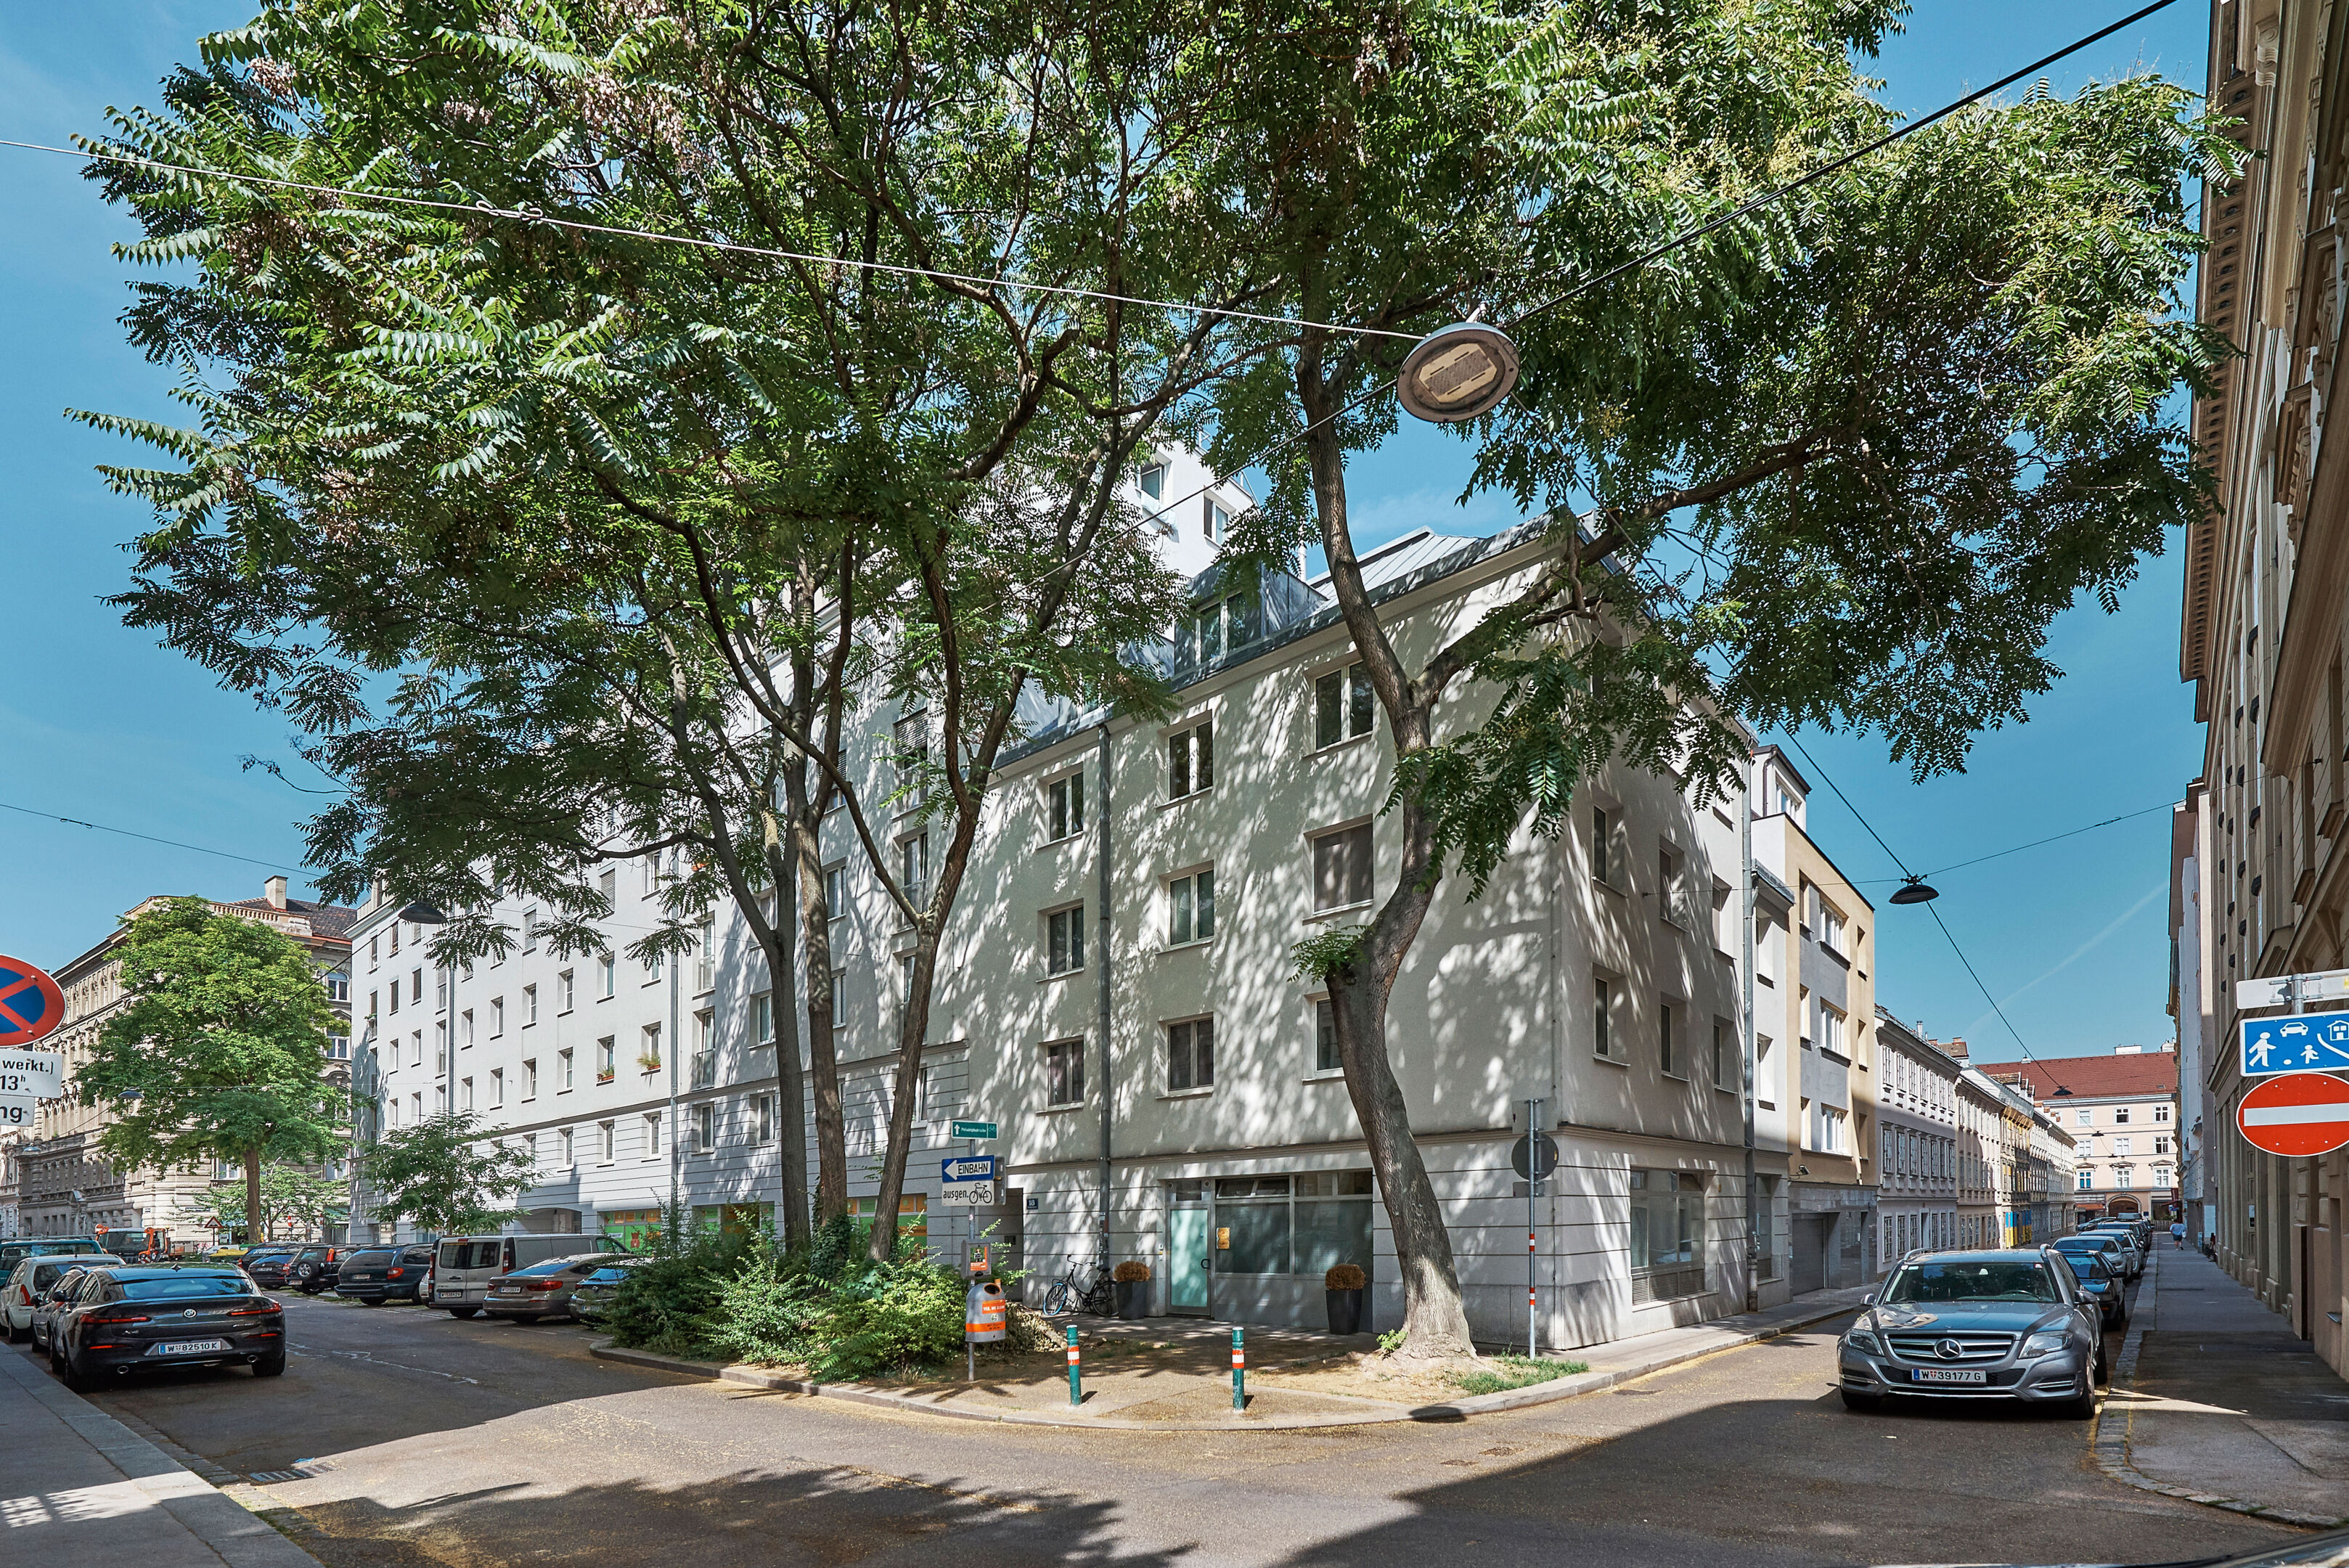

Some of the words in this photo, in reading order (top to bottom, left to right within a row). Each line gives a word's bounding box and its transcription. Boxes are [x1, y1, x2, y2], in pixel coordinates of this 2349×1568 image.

[958, 1162, 988, 1175] EINBAHN
[943, 1190, 968, 1201] ausgen.
[1921, 1371, 1929, 1379] W
[1937, 1371, 1971, 1381] 39177
[1974, 1372, 1981, 1381] G
